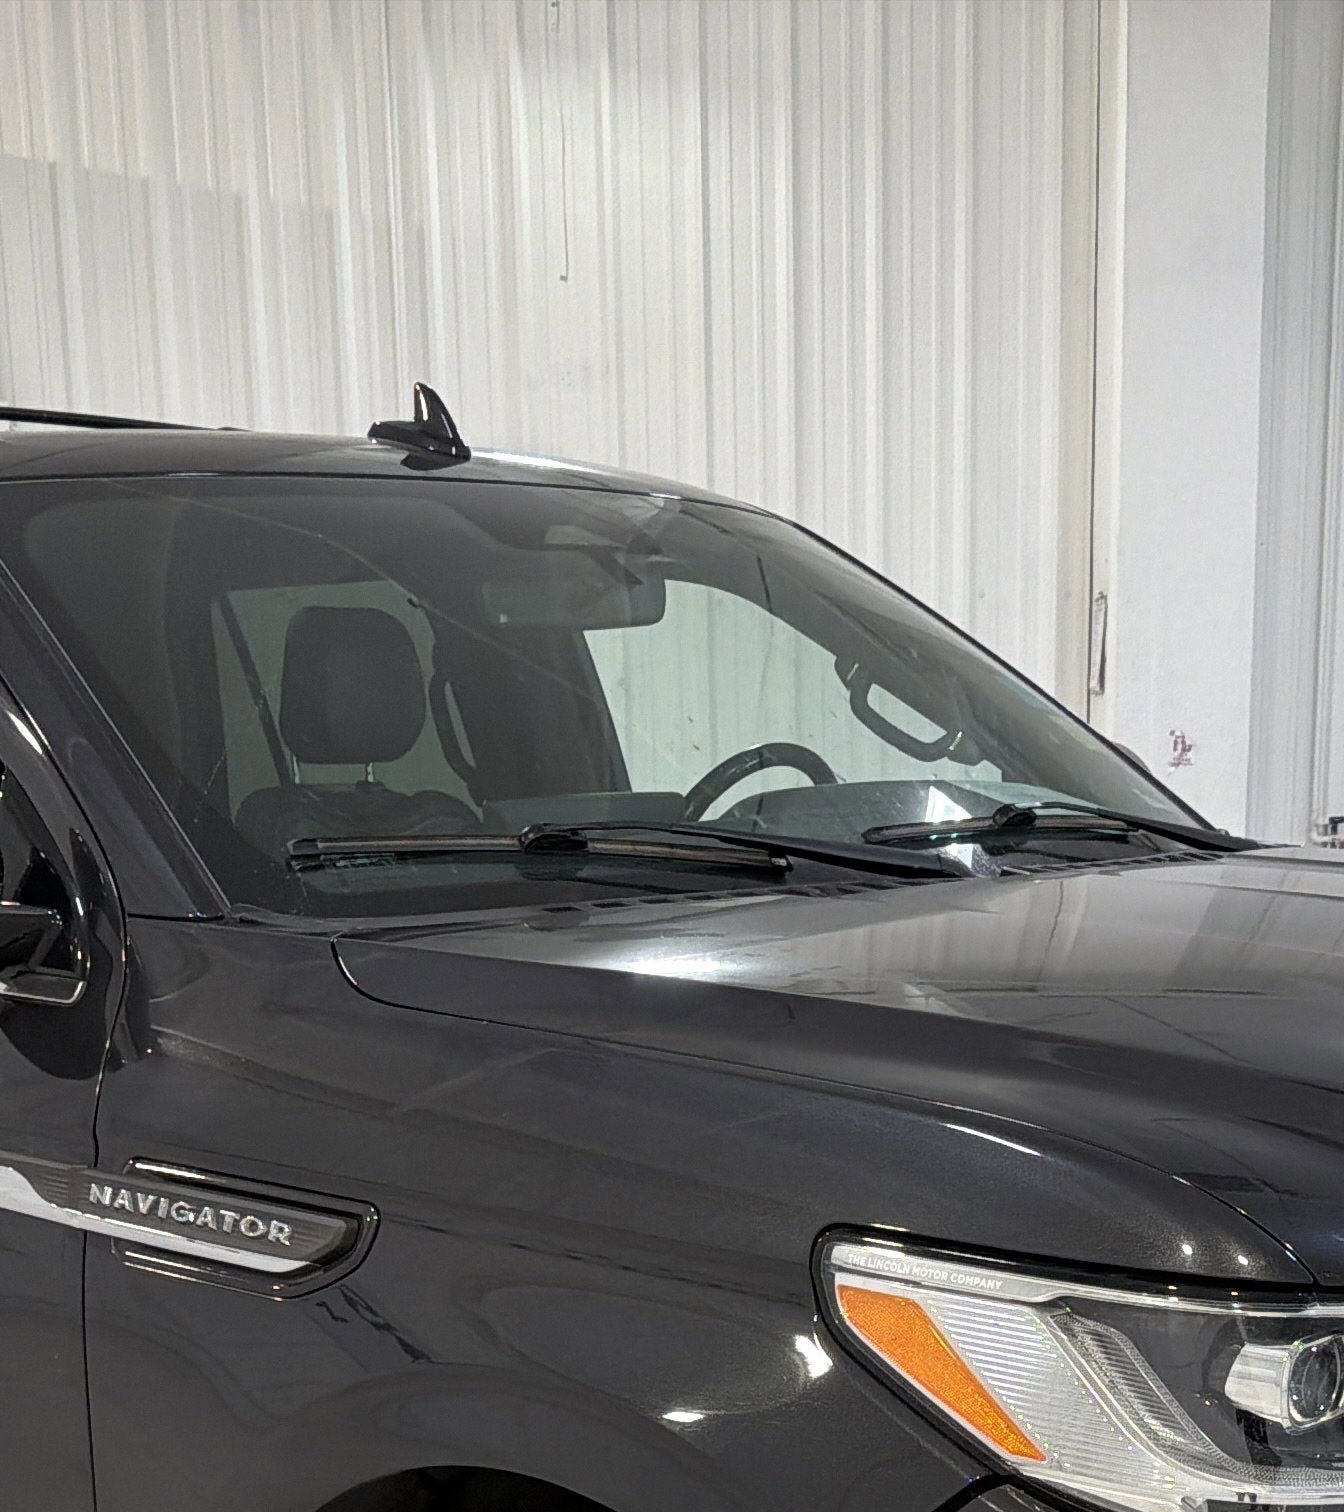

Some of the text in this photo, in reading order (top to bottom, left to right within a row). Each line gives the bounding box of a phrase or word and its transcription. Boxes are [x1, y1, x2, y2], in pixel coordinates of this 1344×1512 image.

[89, 1183, 293, 1246] NAVIGATOR
[847, 1253, 1003, 1290] THE LINCOLN MOTOR COMPANY
